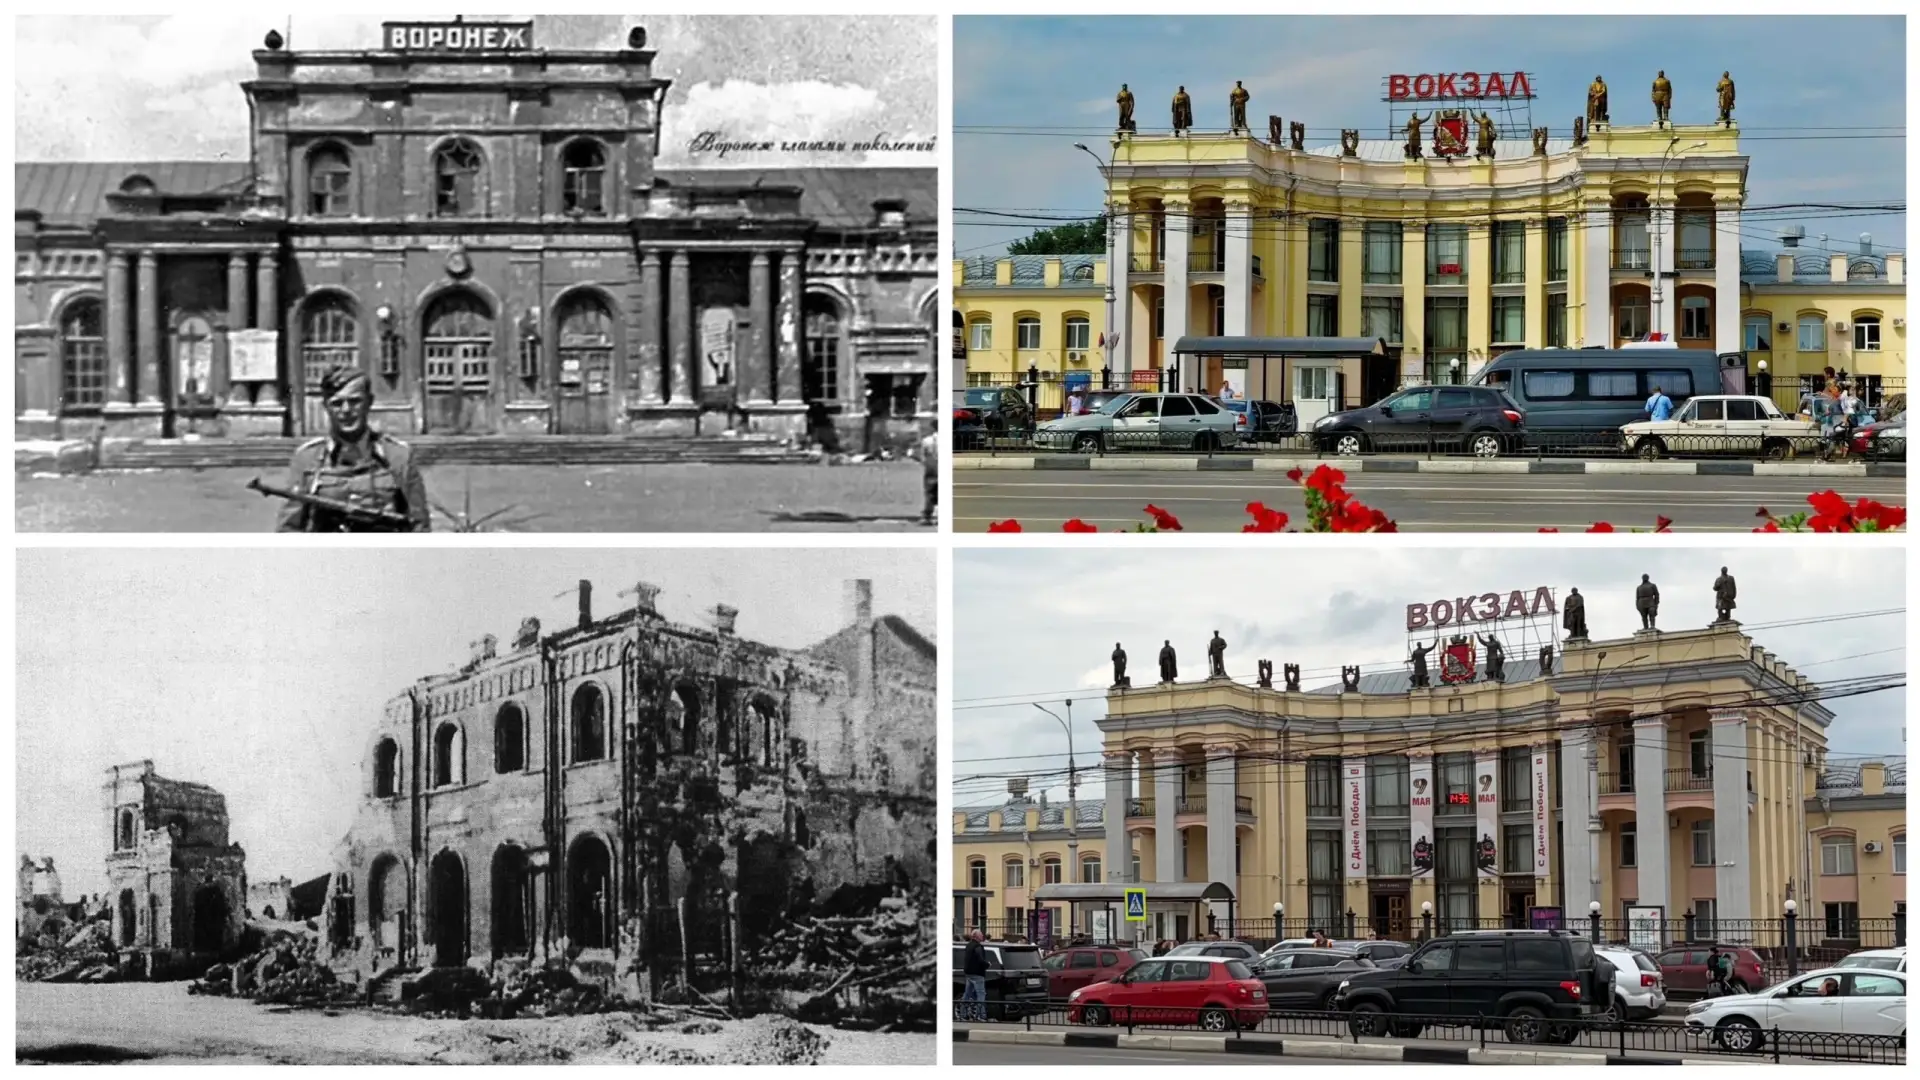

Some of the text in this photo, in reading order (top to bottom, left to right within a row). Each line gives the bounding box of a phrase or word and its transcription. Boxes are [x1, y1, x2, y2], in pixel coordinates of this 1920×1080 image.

[392, 28, 526, 47] ВОРОНЕЖ
[1390, 71, 1530, 98] ВОКЗАЛ
[1407, 586, 1555, 630] ВОКЗАЛ
[1413, 778, 1428, 795] 9
[1479, 774, 1493, 792] 9
[1350, 781, 1361, 826] Победы!
[1412, 797, 1431, 806] МАЯ
[1478, 794, 1496, 803] МАЯ
[1536, 772, 1546, 820] Победы!
